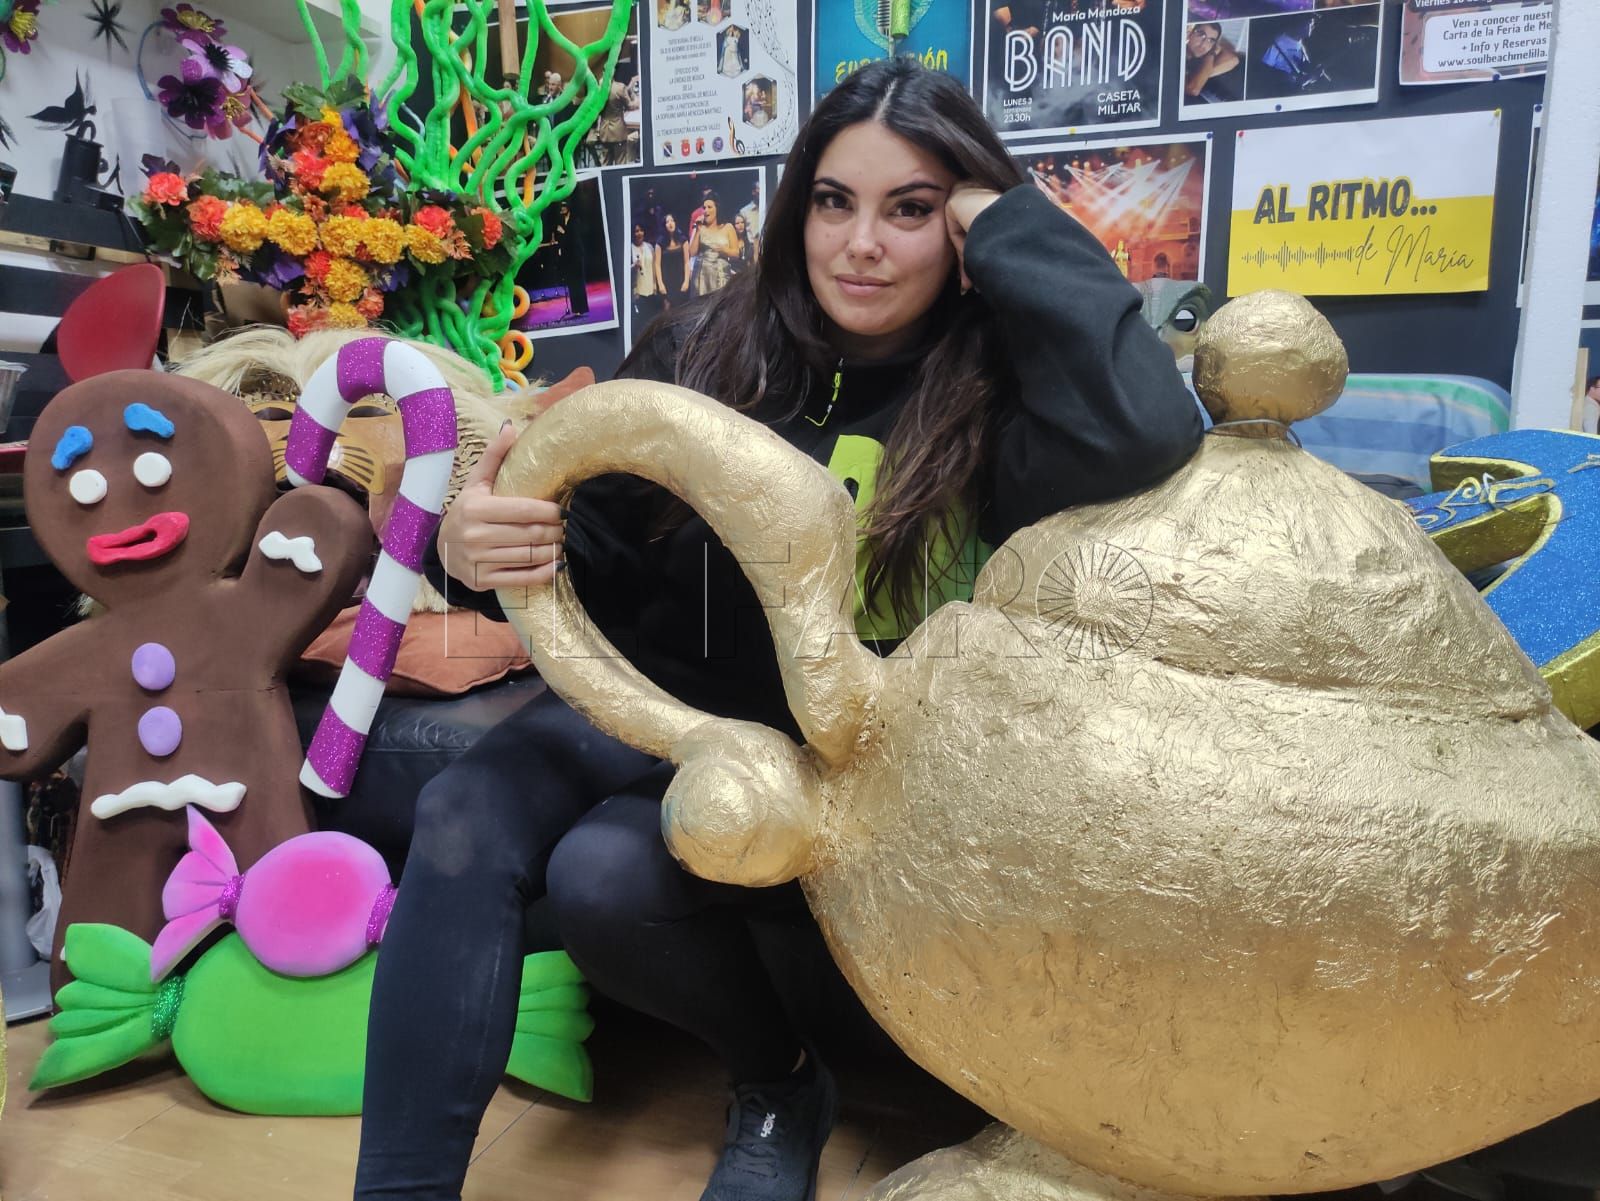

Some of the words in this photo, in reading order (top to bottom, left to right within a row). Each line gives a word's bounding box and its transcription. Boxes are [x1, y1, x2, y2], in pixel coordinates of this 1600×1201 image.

[1052, 10, 1085, 23] María
[1088, 5, 1141, 18] Mendoza
[1452, 18, 1470, 29] Ven
[1482, 15, 1520, 26] conocer
[1523, 11, 1552, 21] nuest
[1443, 30, 1468, 40] Carta
[1471, 28, 1482, 38] de
[1486, 27, 1494, 36] la
[1496, 24, 1521, 35] Feria
[1523, 22, 1535, 32] de
[1470, 42, 1490, 53] Info
[1494, 42, 1499, 52] y
[1503, 37, 1547, 49] Reservas
[1004, 18, 1146, 92] BAND
[1438, 48, 1548, 67] www.soulbeachmelilla.
[1003, 97, 1027, 107] LUNES
[1097, 90, 1141, 103] CASETA
[1098, 103, 1141, 116] MILITAR
[1253, 186, 1295, 224] AL
[1307, 178, 1438, 222] RITMO...
[1353, 225, 1379, 276] de
